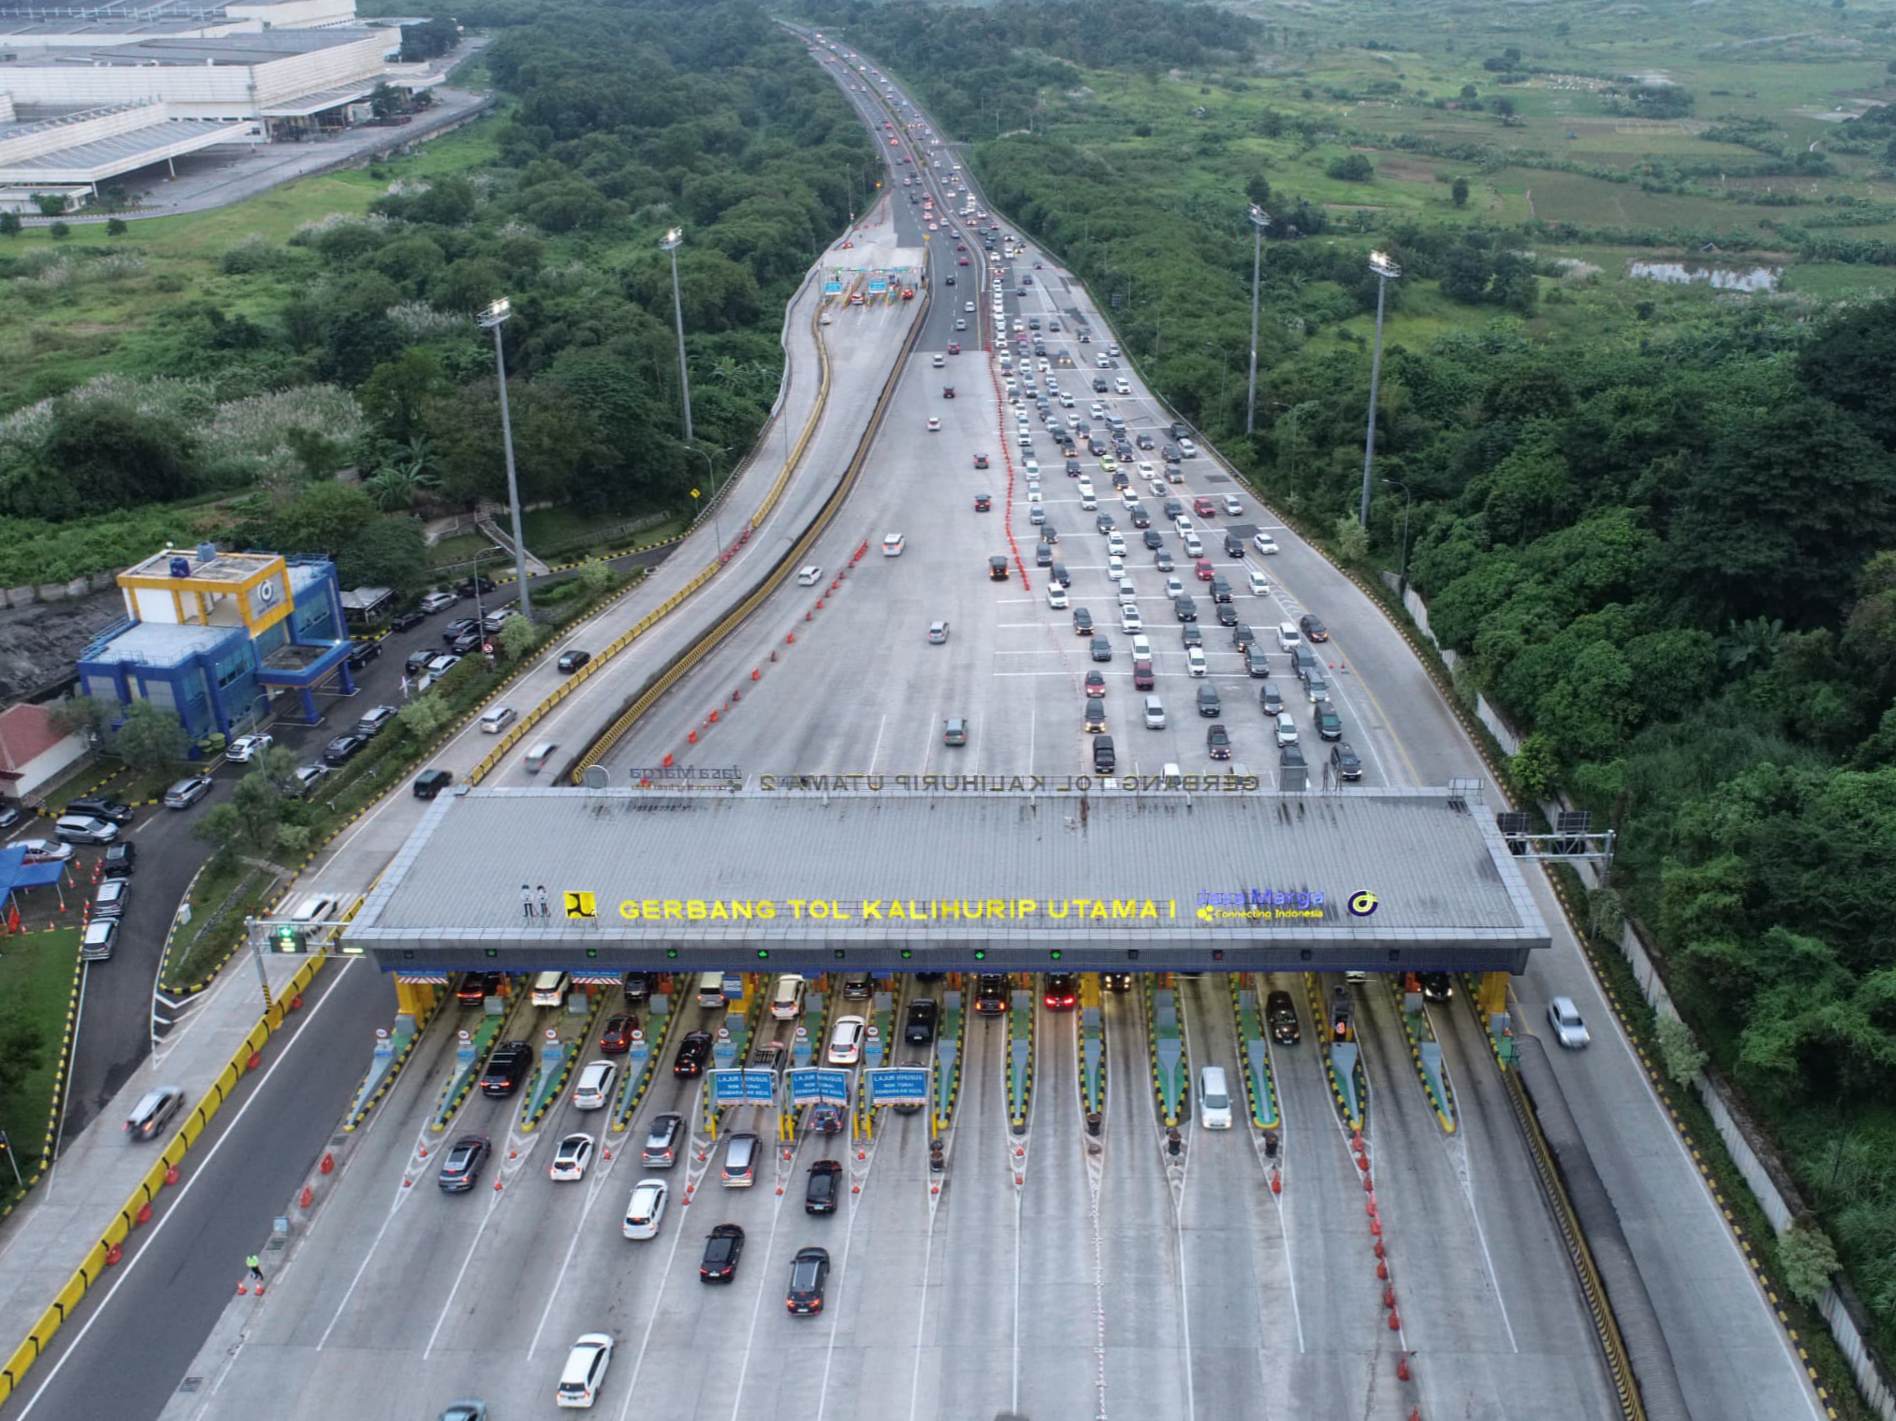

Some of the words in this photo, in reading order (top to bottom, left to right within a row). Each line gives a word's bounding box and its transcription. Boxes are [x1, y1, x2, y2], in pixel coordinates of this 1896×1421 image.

[1197, 888, 1245, 905] Jasa
[1250, 888, 1324, 909] Marga
[618, 899, 776, 921] GERBANG
[786, 899, 850, 921] TOL
[862, 899, 1037, 921] KALIHURIP
[1047, 899, 1158, 921] UTAMA
[1214, 909, 1272, 920] Connecting
[1274, 909, 1324, 919] Indonesia
